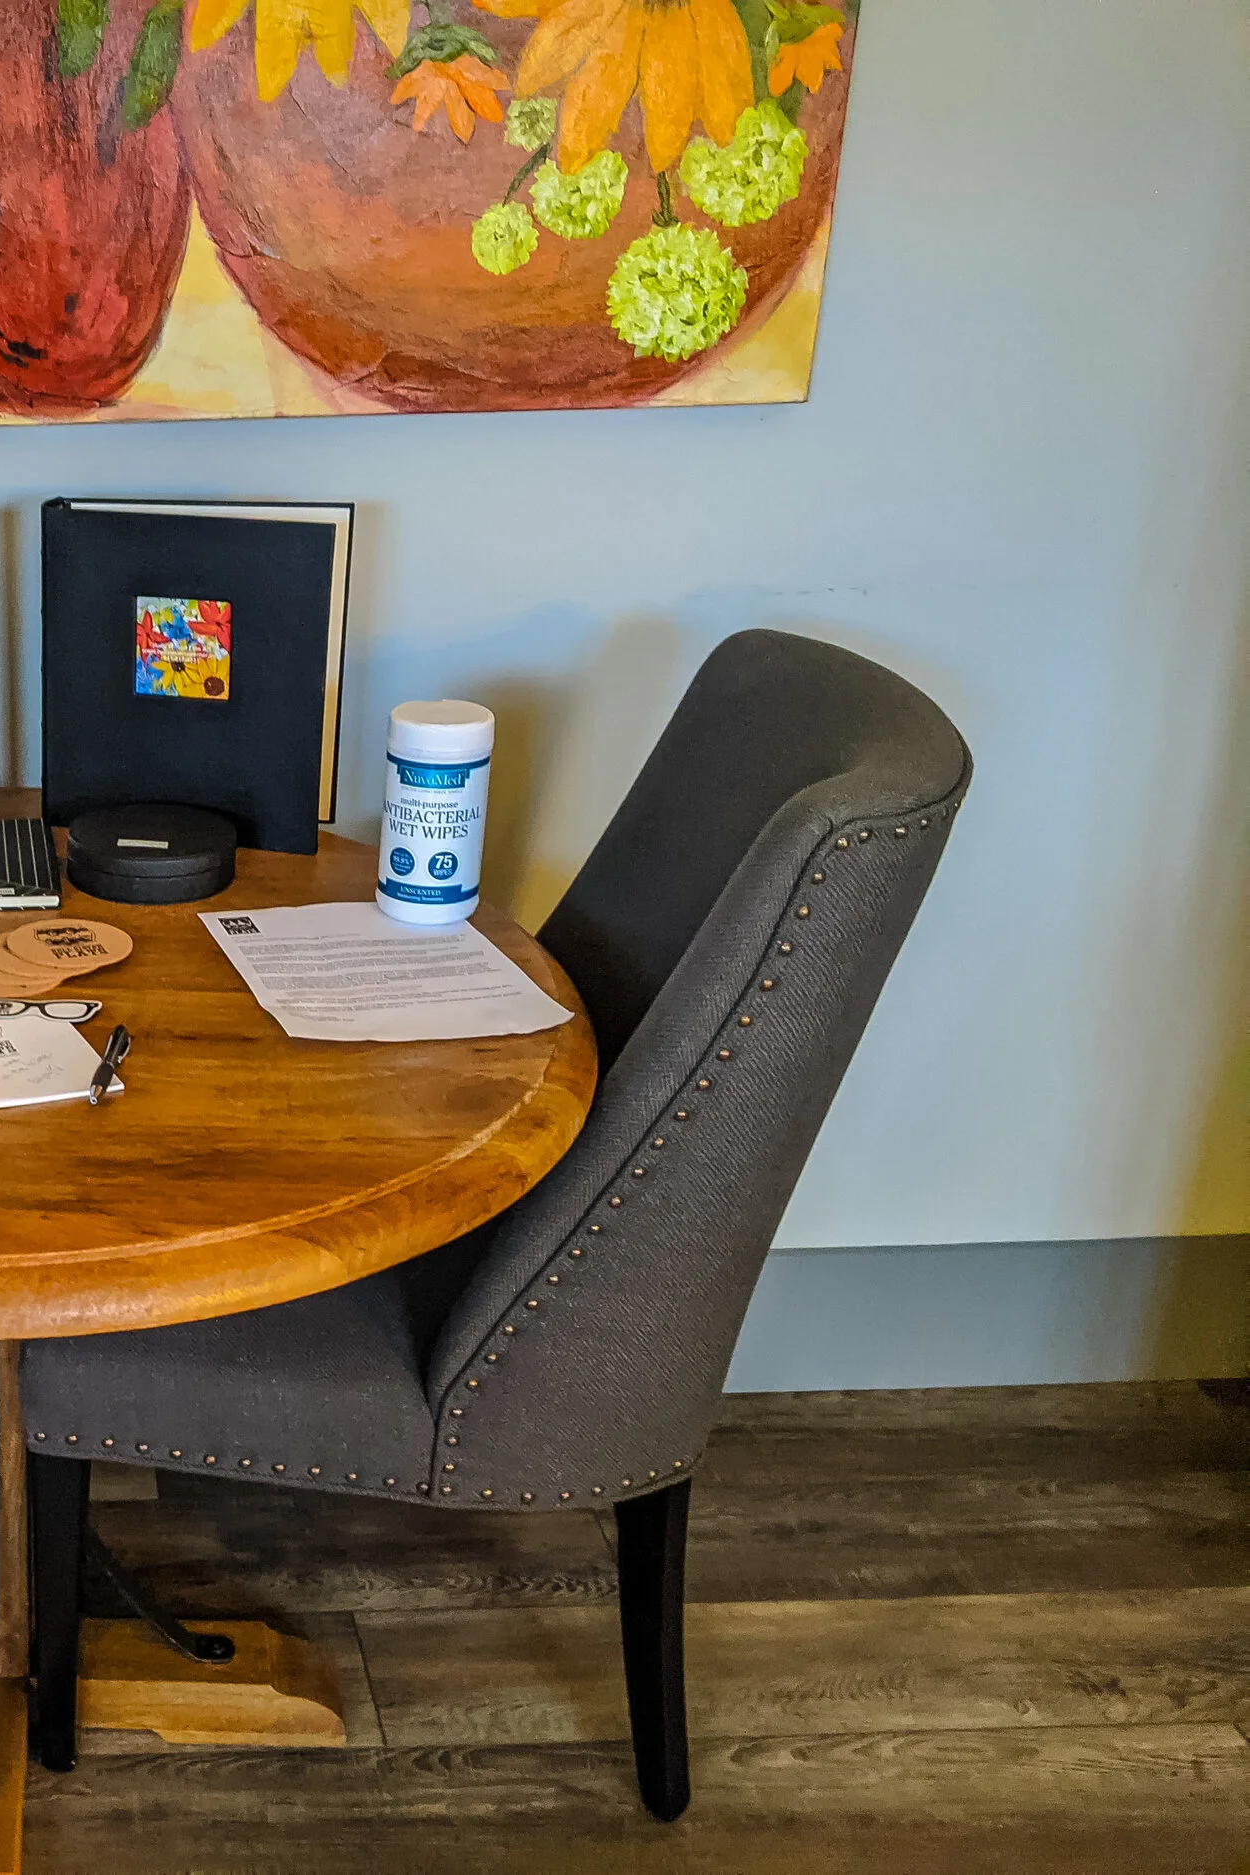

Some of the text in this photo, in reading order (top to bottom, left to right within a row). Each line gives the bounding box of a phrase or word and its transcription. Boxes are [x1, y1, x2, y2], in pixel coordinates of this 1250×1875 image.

[400, 797, 459, 810] multi-purpose
[389, 818, 469, 840] WET WIPES
[435, 855, 453, 869] 75
[400, 886, 441, 896] UNSCENTED
